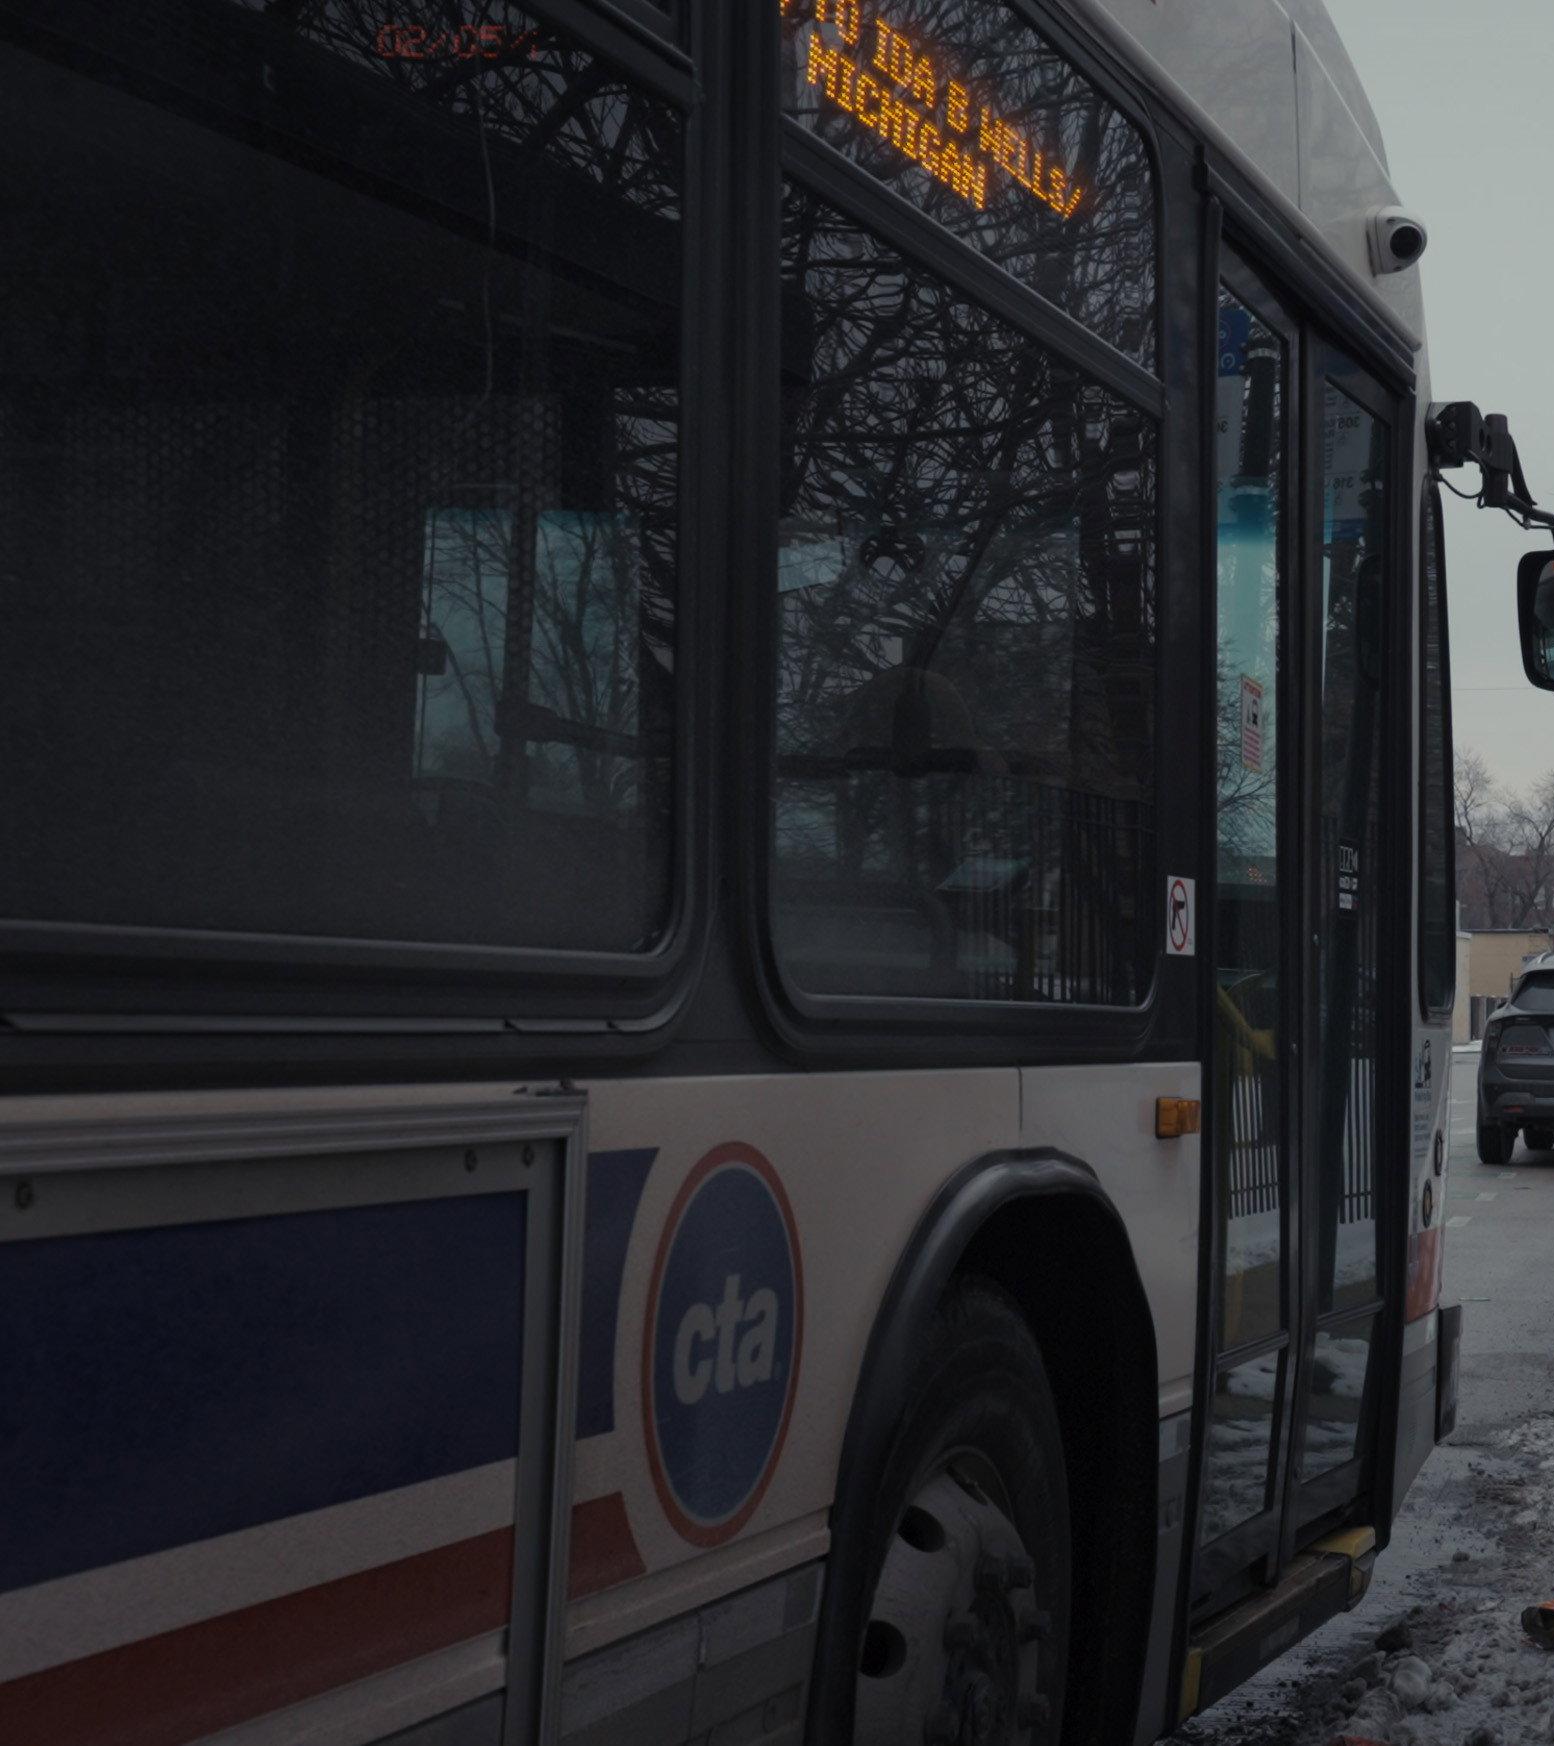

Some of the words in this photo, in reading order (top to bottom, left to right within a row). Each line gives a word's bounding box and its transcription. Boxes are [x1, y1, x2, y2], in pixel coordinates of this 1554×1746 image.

[806, 32, 986, 211] MICHIGAN
[873, 18, 935, 108] IDA
[946, 79, 970, 134] B
[672, 1274, 779, 1406] cta
